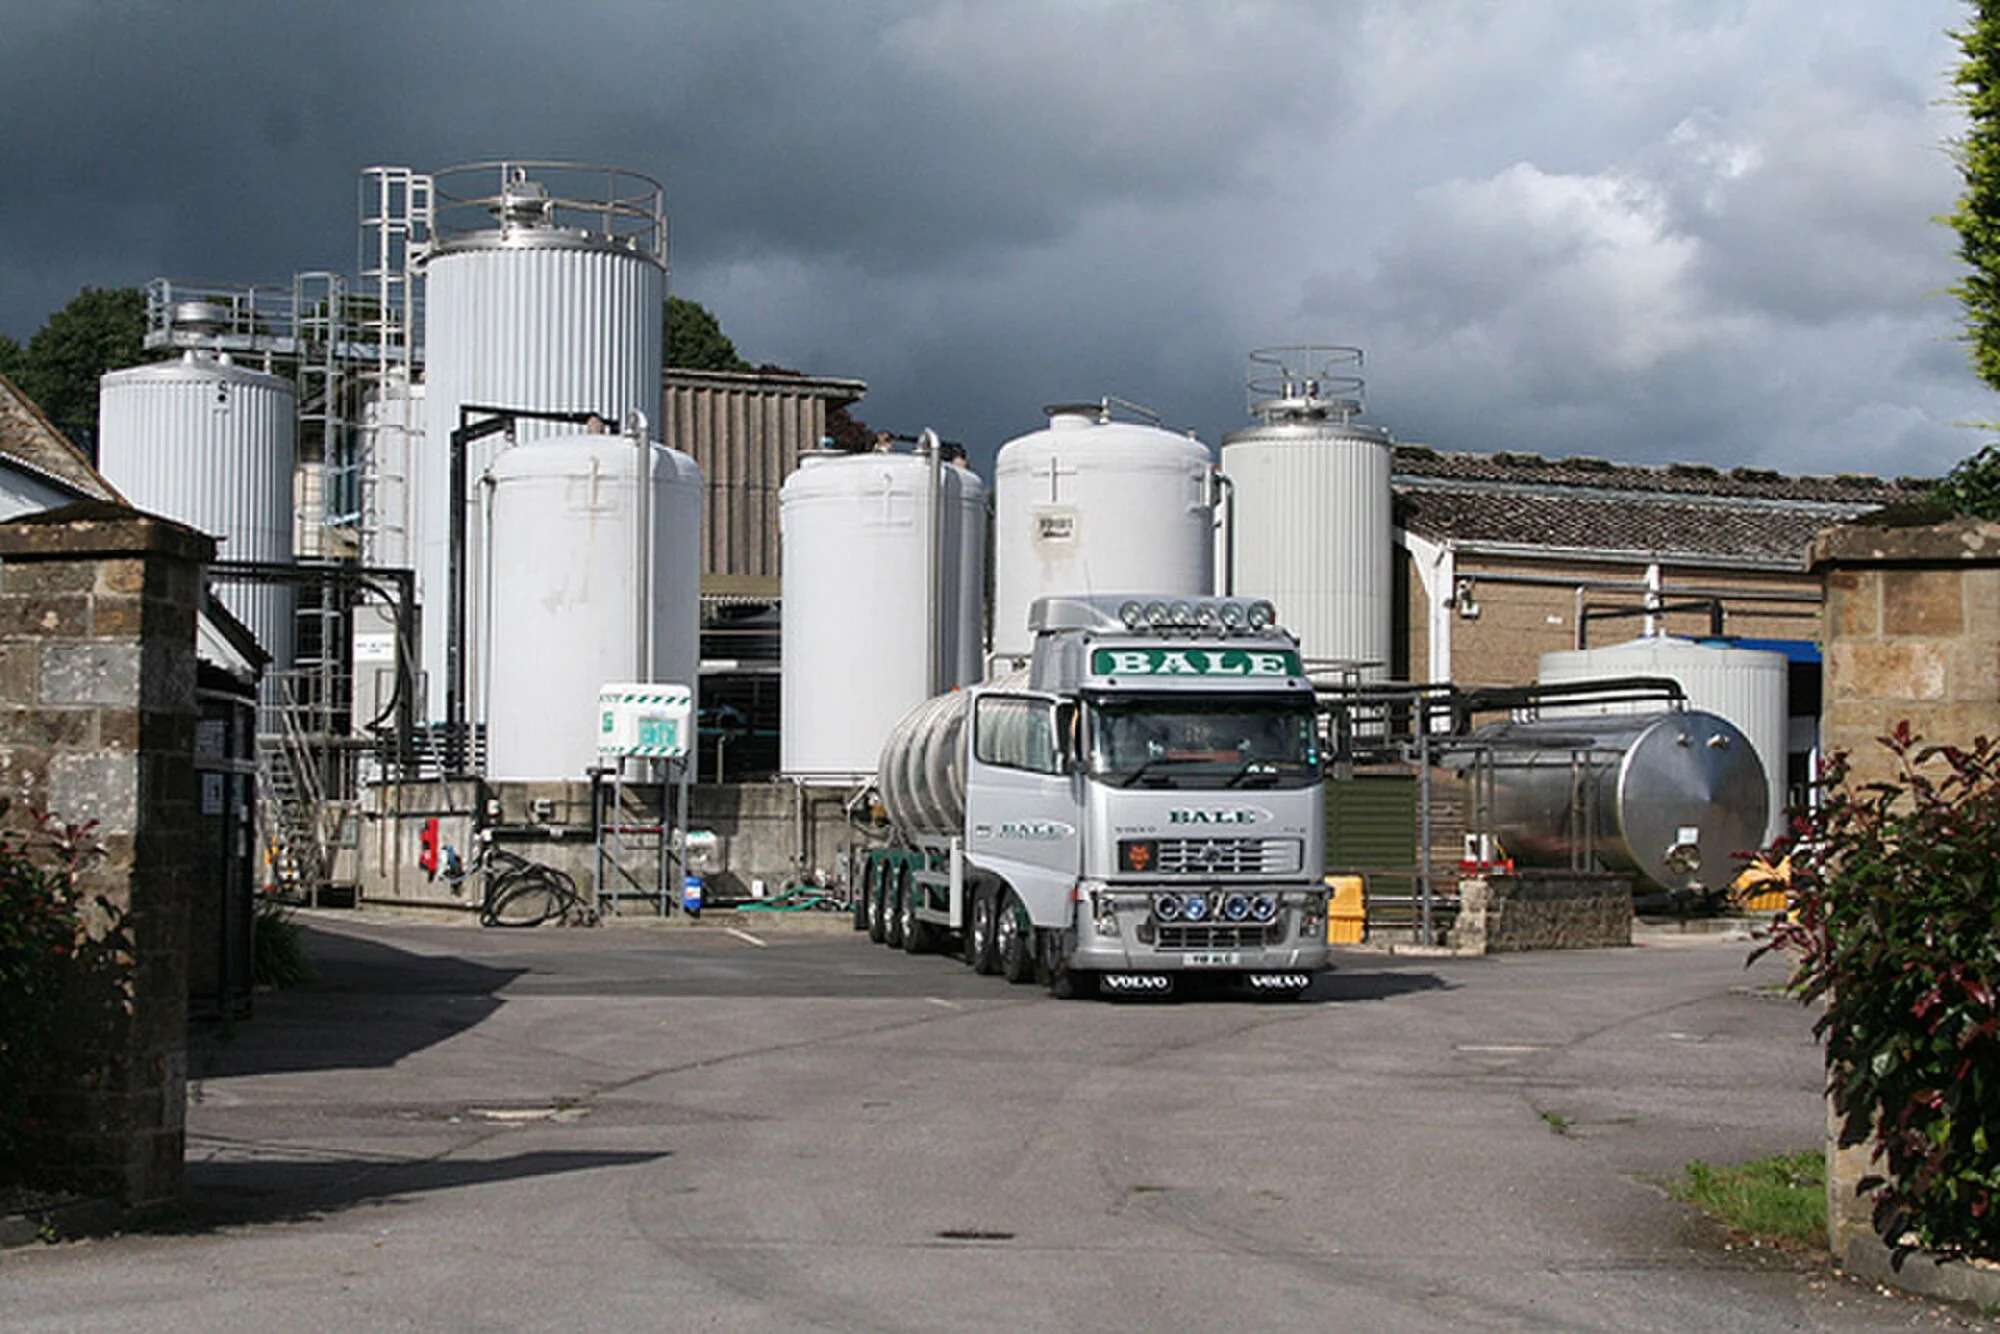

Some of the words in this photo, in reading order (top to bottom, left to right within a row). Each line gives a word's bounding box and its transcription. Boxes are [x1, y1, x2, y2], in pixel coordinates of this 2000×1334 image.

[1109, 652, 1287, 675] BALE
[1168, 810, 1257, 824] BALE
[1106, 974, 1168, 988] VOLVO
[1250, 974, 1309, 988] VOLVO
